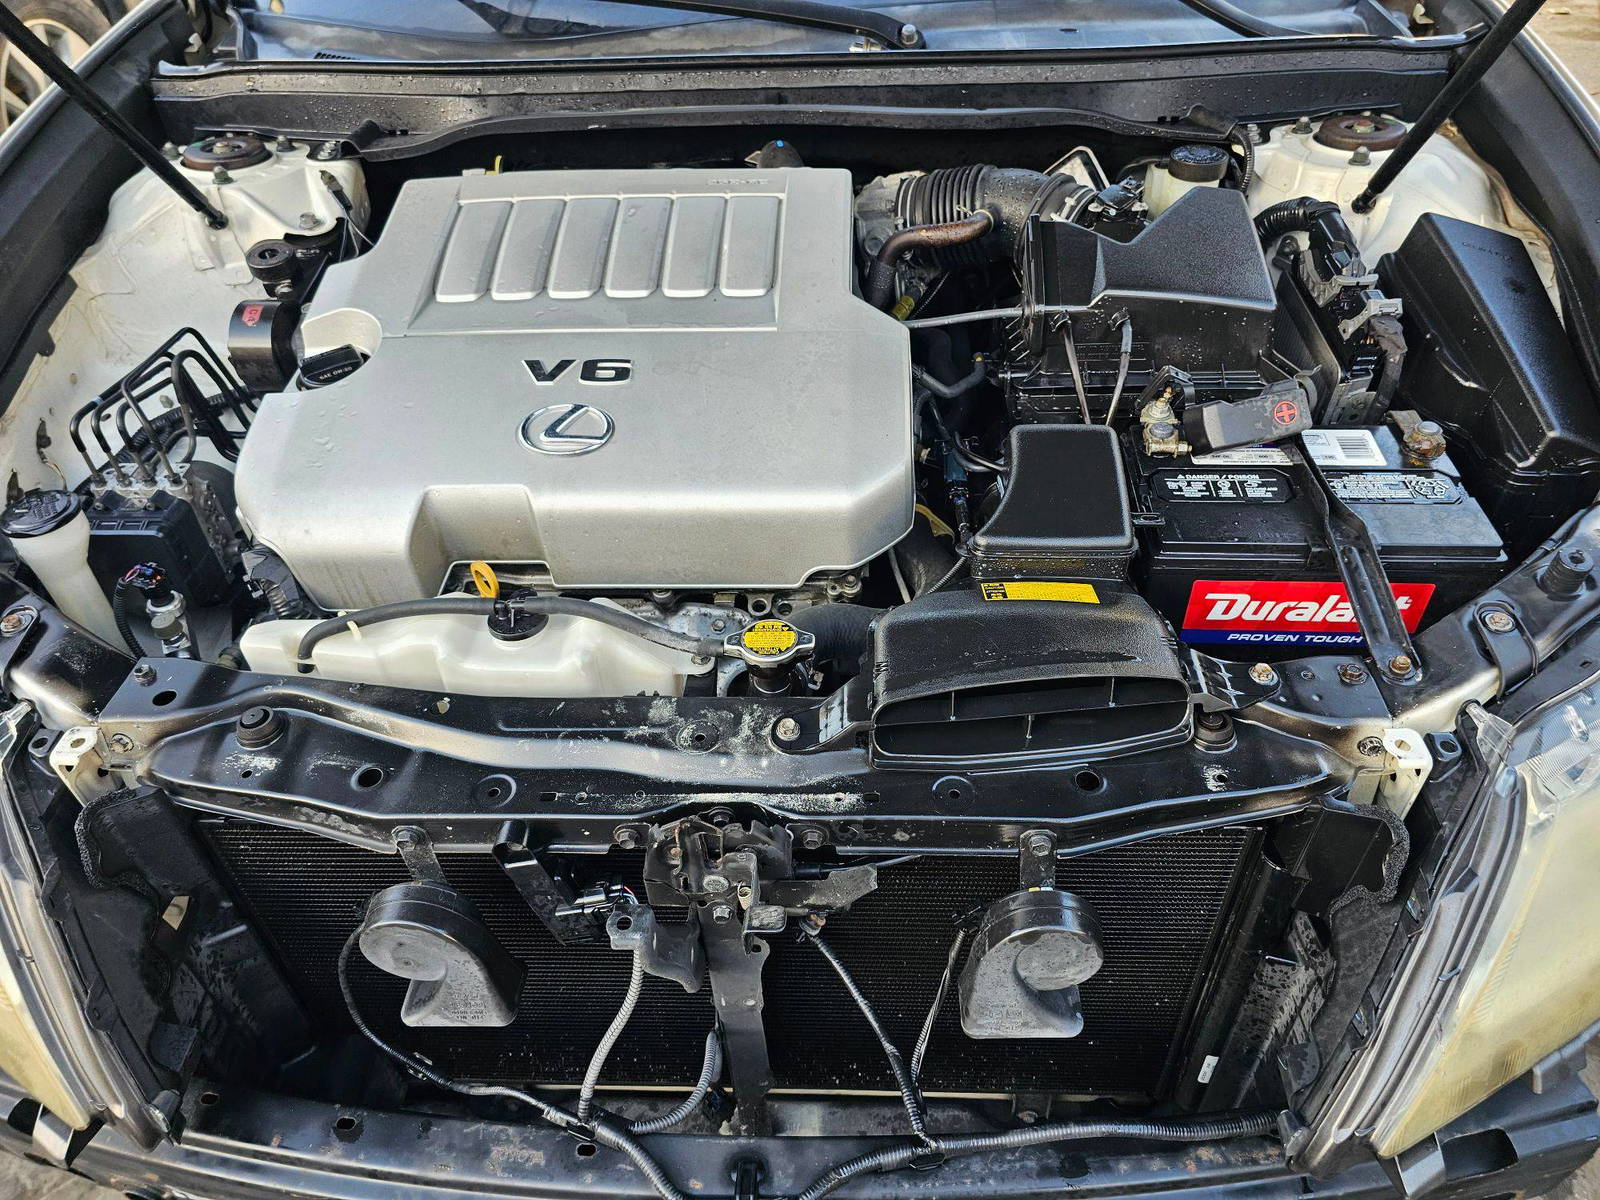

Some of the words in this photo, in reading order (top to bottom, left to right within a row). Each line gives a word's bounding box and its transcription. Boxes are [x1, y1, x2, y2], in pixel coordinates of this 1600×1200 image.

[521, 358, 634, 386] V6
[1204, 593, 1413, 622] Duralat
[1227, 633, 1299, 643] PROVEN
[1304, 634, 1363, 644] TOUGH
